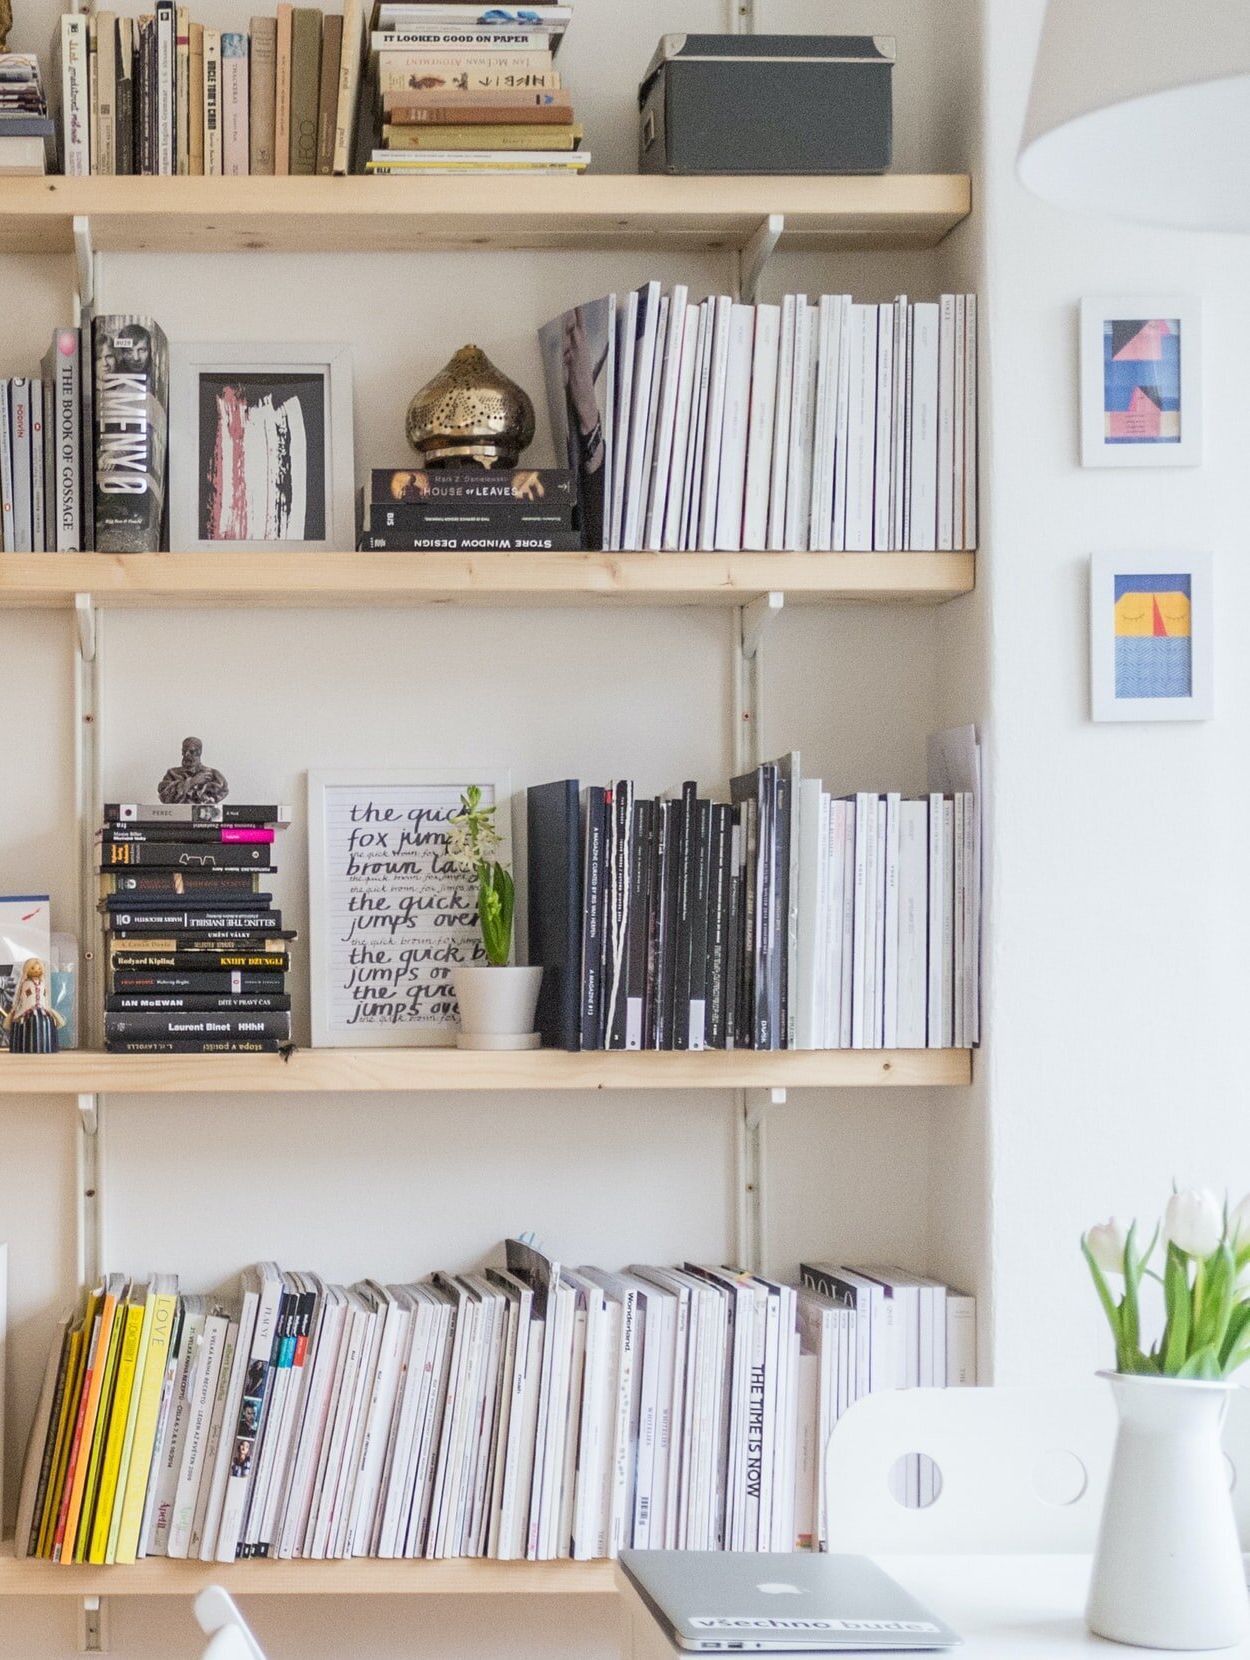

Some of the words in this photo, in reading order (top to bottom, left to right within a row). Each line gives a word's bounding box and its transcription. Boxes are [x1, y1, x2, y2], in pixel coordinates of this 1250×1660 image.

[384, 35, 393, 43] IT
[396, 35, 440, 43] LOOKED
[443, 35, 473, 43] GOOD
[476, 35, 491, 43] ON
[493, 35, 528, 44] PAPER
[207, 61, 216, 82] UNCLE
[207, 85, 216, 107] TOM'S
[207, 109, 216, 130] CABIN
[62, 365, 73, 395] THE
[62, 400, 73, 441] BOOK
[99, 373, 148, 473] KMENY
[62, 444, 73, 463] OF
[62, 467, 74, 531] GOSSAGE
[424, 487, 463, 496] HOUSE
[476, 487, 519, 496] LEAVES
[413, 539, 457, 548] DESIGN
[461, 539, 511, 548] WINDOW
[515, 539, 552, 548] STORE
[349, 801, 403, 822] the
[347, 828, 388, 851] fox
[346, 857, 422, 875] brown
[348, 893, 391, 911] the
[399, 890, 469, 921] quick
[190, 919, 225, 927] INVISIBLE
[226, 919, 243, 927] THE
[244, 919, 276, 927] SELLING
[341, 914, 418, 942] jumps
[433, 913, 480, 927] over
[230, 930, 250, 938] VÁLKY
[118, 957, 148, 966] Rudyard
[148, 957, 175, 967] Kipling
[220, 957, 247, 966] KNIHY
[348, 945, 392, 965] the
[399, 944, 465, 974] quick
[343, 966, 419, 989] jumps
[121, 999, 138, 1007] IAN
[140, 999, 184, 1007] McEWAN
[238, 998, 258, 1006] PRAVÝ
[258, 998, 271, 1006] ČAS
[352, 985, 397, 1000] the
[346, 1000, 422, 1024] jumps
[168, 1022, 204, 1032] Laurent
[205, 1022, 231, 1032] Binet
[238, 1022, 265, 1032] HHhH
[239, 1043, 263, 1051] stopa
[151, 1298, 171, 1348] LOVE
[260, 1307, 273, 1339] FLAUNT
[624, 1292, 635, 1352] Wonderland.
[208, 1335, 217, 1355] VELKÁ
[182, 1355, 192, 1374] KNIHA
[204, 1356, 214, 1376] KNIHA
[750, 1364, 765, 1394] THE
[200, 1377, 210, 1404] RECEPTŮ
[195, 1410, 205, 1430] LEDEN
[749, 1398, 764, 1434] TIME
[193, 1431, 202, 1440] AŽ
[748, 1439, 762, 1452] IS
[189, 1441, 200, 1465] KVĚTEN
[747, 1458, 762, 1498] NOW
[157, 1502, 171, 1529] Apetit
[698, 1618, 831, 1629] všechno
[840, 1621, 936, 1632] bude.
